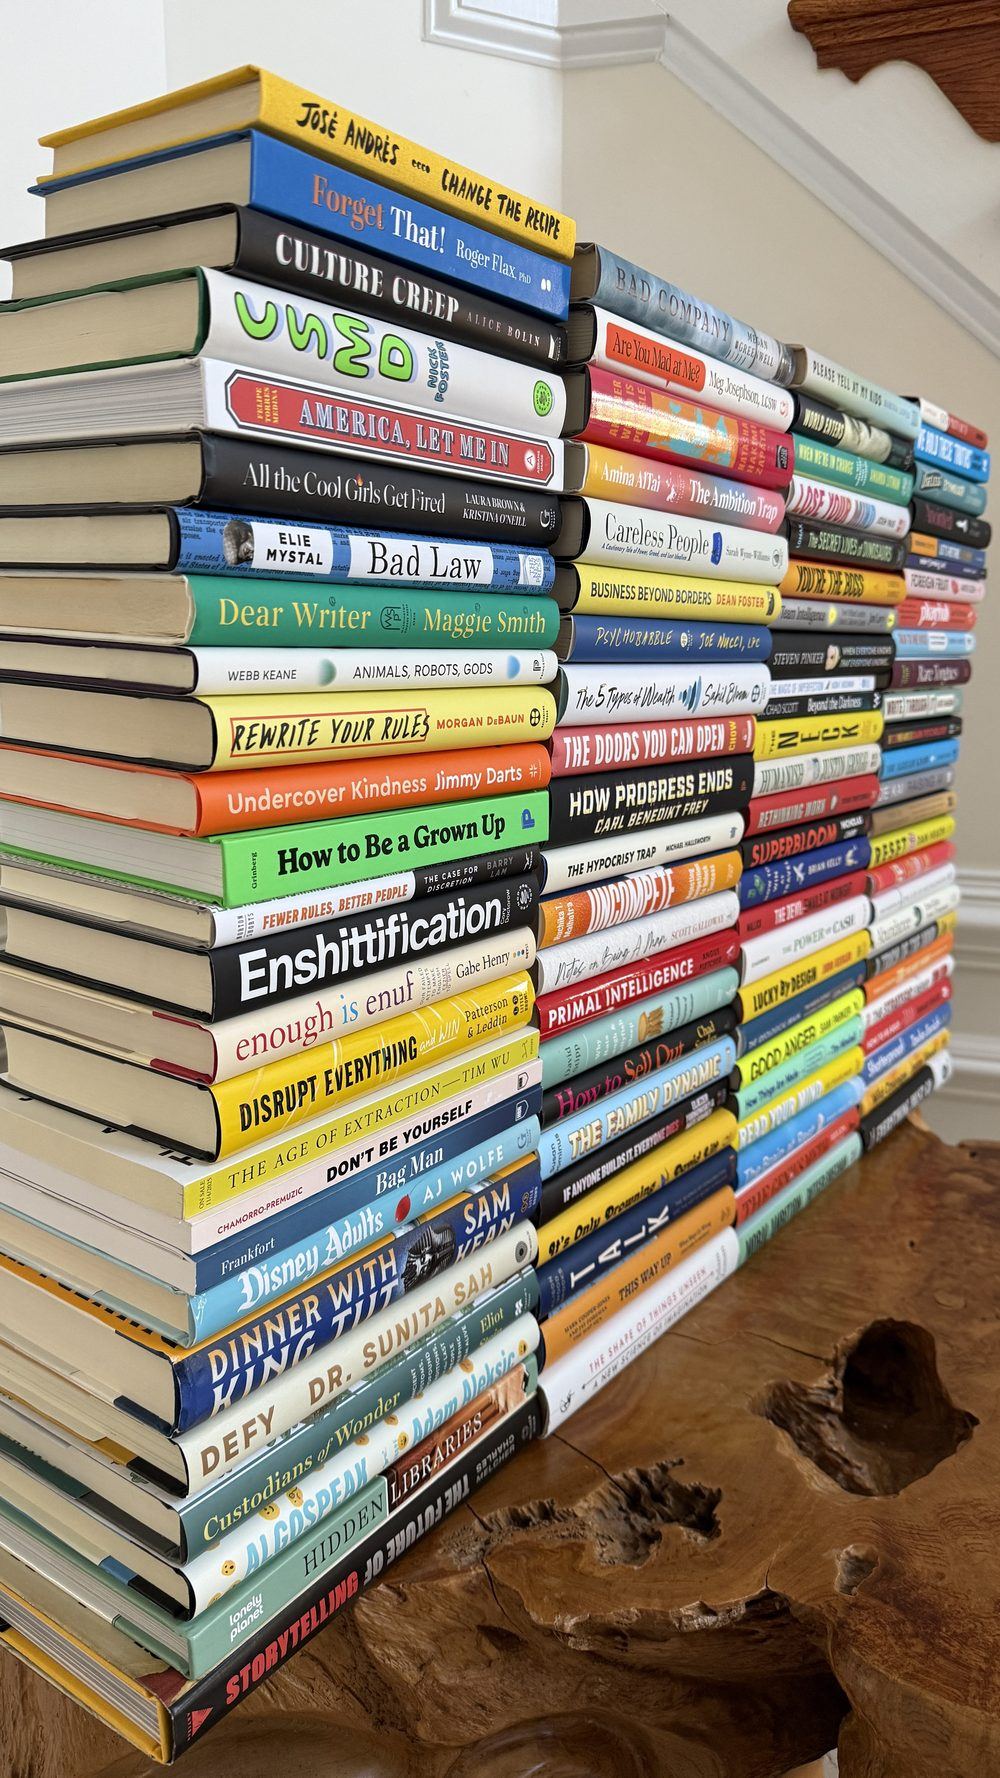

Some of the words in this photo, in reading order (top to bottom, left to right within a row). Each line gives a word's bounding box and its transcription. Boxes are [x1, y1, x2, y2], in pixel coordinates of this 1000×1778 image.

[296, 103, 338, 139] JOSÉ
[312, 174, 384, 232] Forget
[390, 206, 446, 254] That!
[441, 168, 492, 211] CHANGE
[497, 194, 521, 222] THE
[525, 208, 561, 240] RECIPE
[275, 233, 384, 298] CULTURE
[392, 276, 459, 323] CREEP
[456, 238, 490, 269] Roger
[518, 272, 532, 285] PhD
[616, 267, 651, 302] BAD
[658, 289, 730, 342] COMPANY
[466, 312, 501, 333] ALICE
[507, 326, 541, 347] BOLIN
[612, 332, 632, 357] Are
[632, 339, 650, 363] You
[651, 349, 671, 374] Mad
[673, 358, 682, 376] at
[683, 360, 701, 384] Me?
[812, 360, 836, 384] PLEASE
[837, 373, 852, 393] YELL
[851, 378, 860, 395] AT
[860, 383, 869, 399] MY
[869, 388, 883, 407] KIDS
[299, 399, 411, 449] AMERICA,
[416, 423, 453, 455] LET
[460, 435, 486, 462] ME
[490, 443, 510, 467] IN
[803, 408, 825, 433] WORLD
[823, 417, 846, 442] EATERS
[242, 462, 270, 488] All
[275, 466, 300, 492] the
[304, 471, 341, 500] Cool
[345, 476, 381, 506] Girls
[384, 484, 409, 509] Get
[411, 488, 446, 515] Fired
[600, 462, 635, 487] Amina
[689, 479, 710, 506] The
[711, 487, 757, 516] Ambition
[757, 497, 778, 525] Trap
[266, 548, 323, 567] MYSTAL
[279, 532, 311, 548] ELIE
[605, 512, 664, 549] Careless
[668, 524, 709, 562] People
[367, 541, 420, 577] Bad
[430, 546, 482, 580] Law
[590, 581, 636, 601] BUSINESS
[637, 585, 674, 604] BEYOND
[675, 587, 712, 606] BORDERS
[716, 592, 737, 606] DEAN
[737, 595, 765, 609] FOSTER
[827, 569, 843, 596] THE
[843, 572, 865, 599] BOSS
[219, 598, 284, 628] Dear
[292, 600, 371, 631] Writer
[424, 607, 492, 639] Maggie
[497, 609, 546, 635] Smith
[227, 669, 261, 682] WEBB
[263, 668, 297, 681] KEANE
[352, 663, 411, 681] ANIMALS,
[414, 663, 461, 678] ROBOTS,
[463, 662, 493, 676] GODS
[773, 652, 800, 666] STEVEN
[800, 650, 825, 665] PINKER
[232, 717, 321, 753] REWRITE
[331, 716, 377, 744] YOUR
[381, 713, 430, 740] RULES
[563, 735, 590, 769] THE
[595, 729, 640, 766] DOORS
[641, 727, 667, 760] YOU
[670, 725, 696, 756] CAN
[697, 723, 725, 752] OPEN
[227, 784, 346, 816] Undercover
[351, 777, 427, 800] Kindness
[434, 770, 482, 792] Jimmy
[486, 765, 522, 785] Darts
[569, 788, 611, 818] HOW
[615, 774, 695, 810] PROGRESS
[698, 768, 734, 795] ENDS
[594, 813, 626, 835] CARL
[627, 803, 683, 828] BENEDIKT
[682, 798, 710, 819] FREY
[758, 802, 805, 829] RETHINKING
[805, 798, 827, 818] WORK
[277, 842, 333, 876] How
[337, 839, 361, 862] to
[365, 832, 393, 860] Be
[397, 834, 410, 852] a
[413, 818, 479, 847] Grown
[482, 813, 506, 840] Up
[567, 863, 585, 878] THE
[586, 852, 635, 876] HYPOCRISY
[636, 846, 657, 863] TRAP
[750, 824, 838, 866] SUPERBLOOM
[808, 861, 826, 876] BRIAN
[826, 855, 843, 871] KELLY
[874, 837, 908, 864] RESET
[262, 908, 299, 931] FEWER
[301, 903, 334, 922] RULES,
[338, 893, 374, 912] BETTER
[375, 883, 408, 904] PEOPLE
[238, 896, 502, 1002] Enshittification
[456, 959, 482, 979] Gabe
[483, 950, 511, 974] Henry
[548, 995, 602, 1029] PRIMAL
[605, 957, 695, 1006] INTELLIGENCE
[753, 987, 780, 1012] LUCKY
[791, 966, 818, 990] DESIGN
[236, 1000, 334, 1062] enough
[342, 993, 359, 1024] is
[366, 970, 415, 1016] enuf
[750, 1047, 783, 1081] GOOD
[783, 1025, 817, 1056] ANGER
[239, 1074, 318, 1132] DISRUPT
[324, 1035, 418, 1097] EVERYTHING
[379, 1137, 399, 1157] BE
[403, 1100, 473, 1145] YOURSELF
[567, 1117, 603, 1160] THE
[605, 1087, 663, 1140] FAMILY
[662, 1055, 722, 1107] DYNAMIC
[375, 1165, 406, 1197] Bag
[409, 1147, 444, 1178] Man
[423, 1182, 443, 1204] AJ
[451, 1144, 505, 1186] WOLFE
[217, 1186, 304, 1235] CHAMORRO-PREMUZIC
[463, 1182, 511, 1235] SAM
[220, 1236, 276, 1276] Frankfort
[237, 1242, 319, 1312] Disney
[322, 1206, 385, 1267] Adults
[617, 1277, 640, 1302] THIS
[640, 1264, 661, 1286] WAY
[660, 1252, 673, 1272] UP
[208, 1294, 323, 1384] DINNER
[328, 1247, 398, 1312] WITH
[200, 1405, 276, 1478] DEFY
[308, 1364, 352, 1407] DR.
[362, 1296, 446, 1369] SUNITA
[454, 1263, 493, 1299] SAH
[203, 1454, 314, 1544] Custodians
[317, 1441, 335, 1464] of
[334, 1390, 402, 1446] Wonder
[302, 1492, 386, 1578] HIDDEN
[390, 1411, 485, 1505] LIBRARIES
[445, 1473, 470, 1513] THE
[386, 1497, 443, 1565] FUTURE
[363, 1553, 385, 1586] OF
[229, 1592, 263, 1626] lonely
[230, 1604, 264, 1643] planet
[226, 1570, 360, 1705] STORYTELLING
